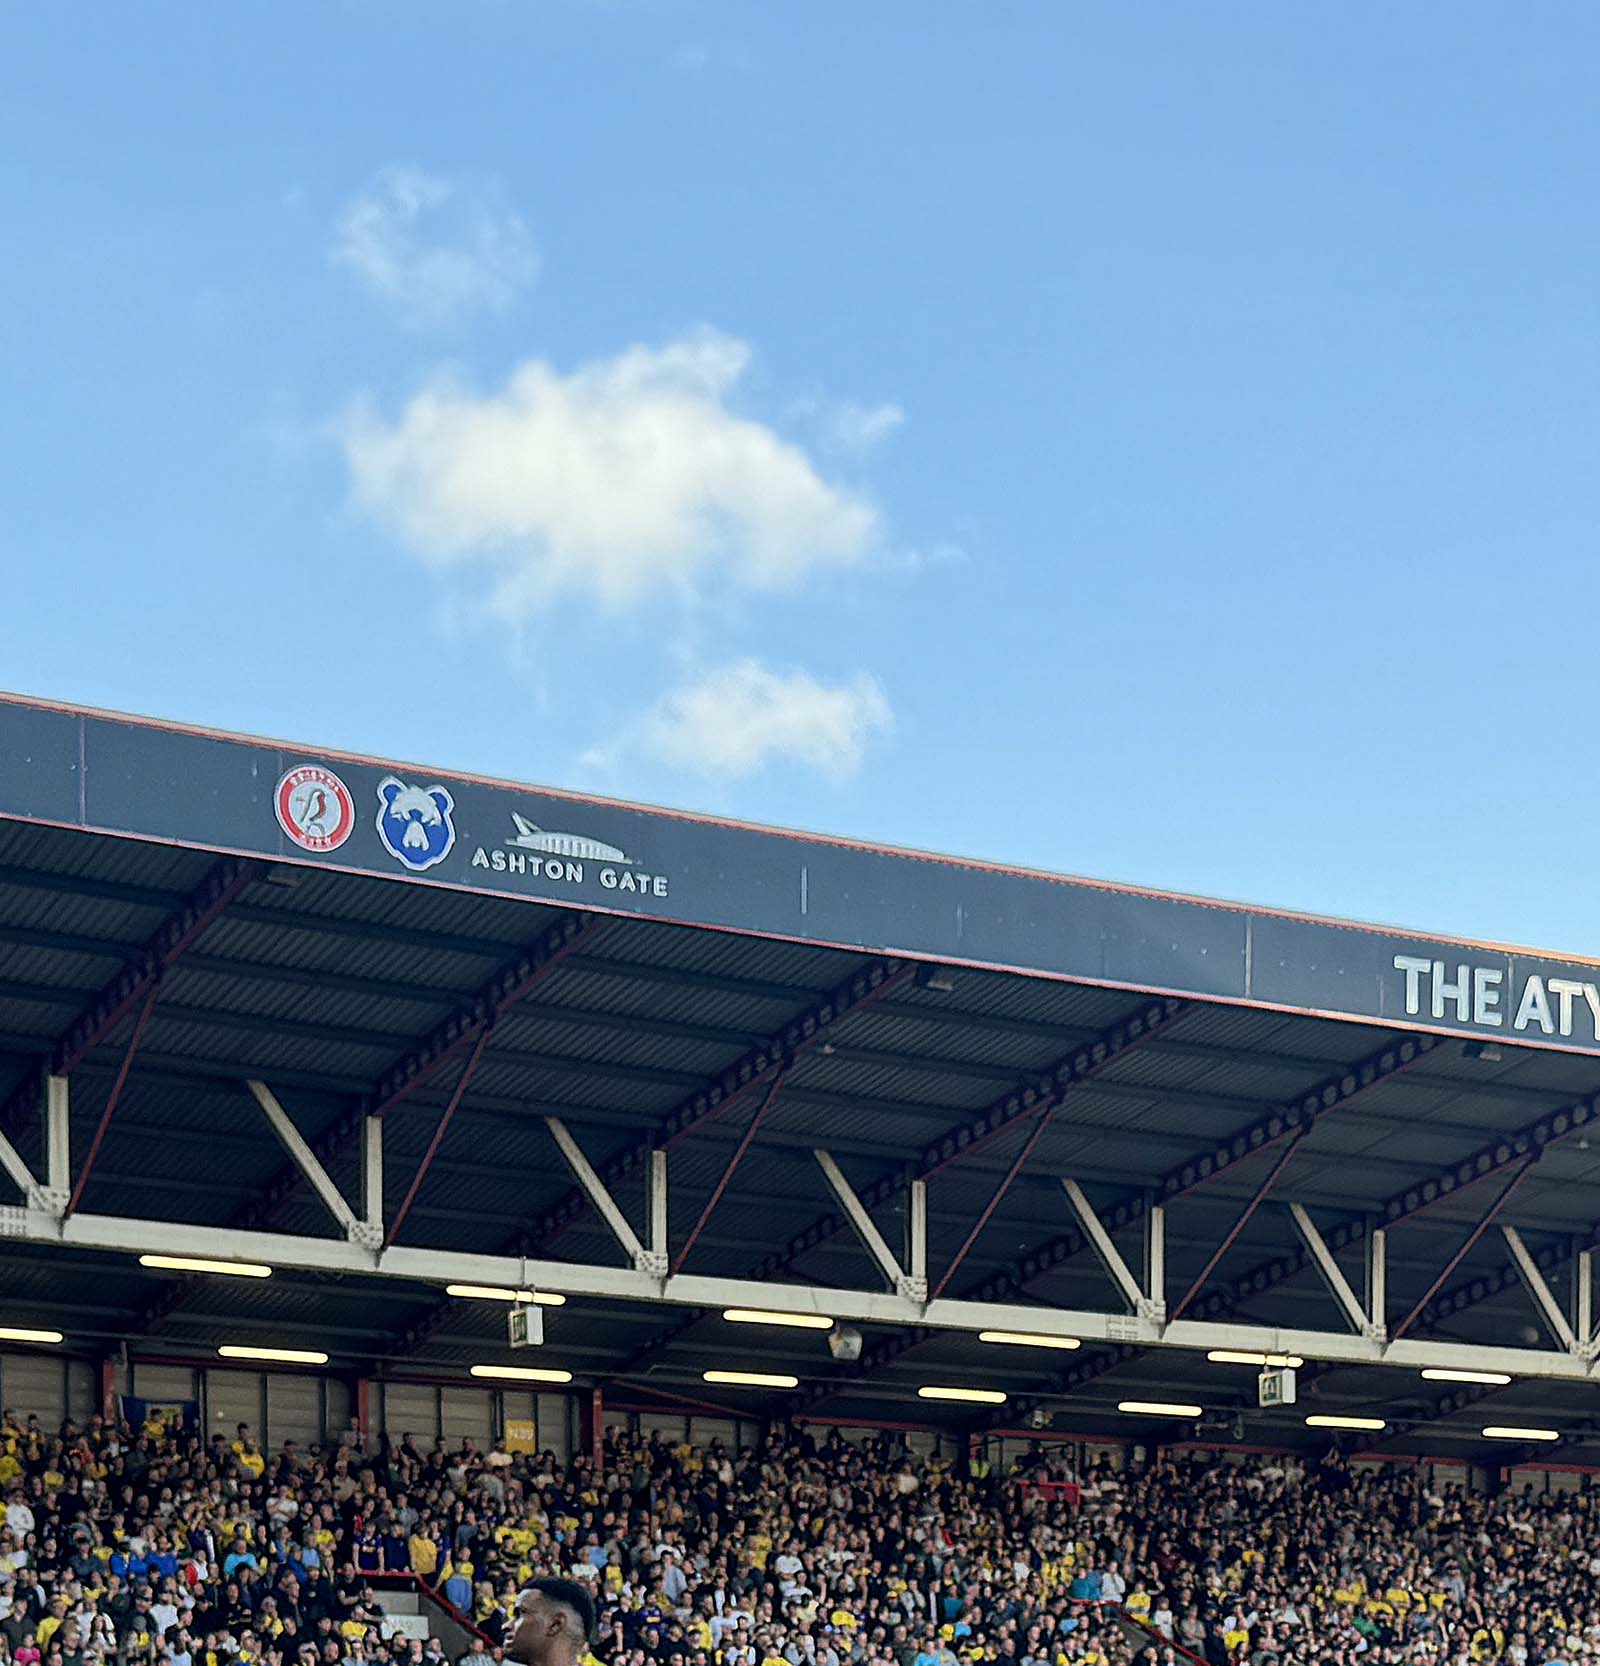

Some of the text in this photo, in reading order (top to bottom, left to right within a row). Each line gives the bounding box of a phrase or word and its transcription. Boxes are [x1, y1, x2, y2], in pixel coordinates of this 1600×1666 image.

[472, 847, 669, 897] ASHTON GATE
[1393, 955, 1504, 1027] THE
